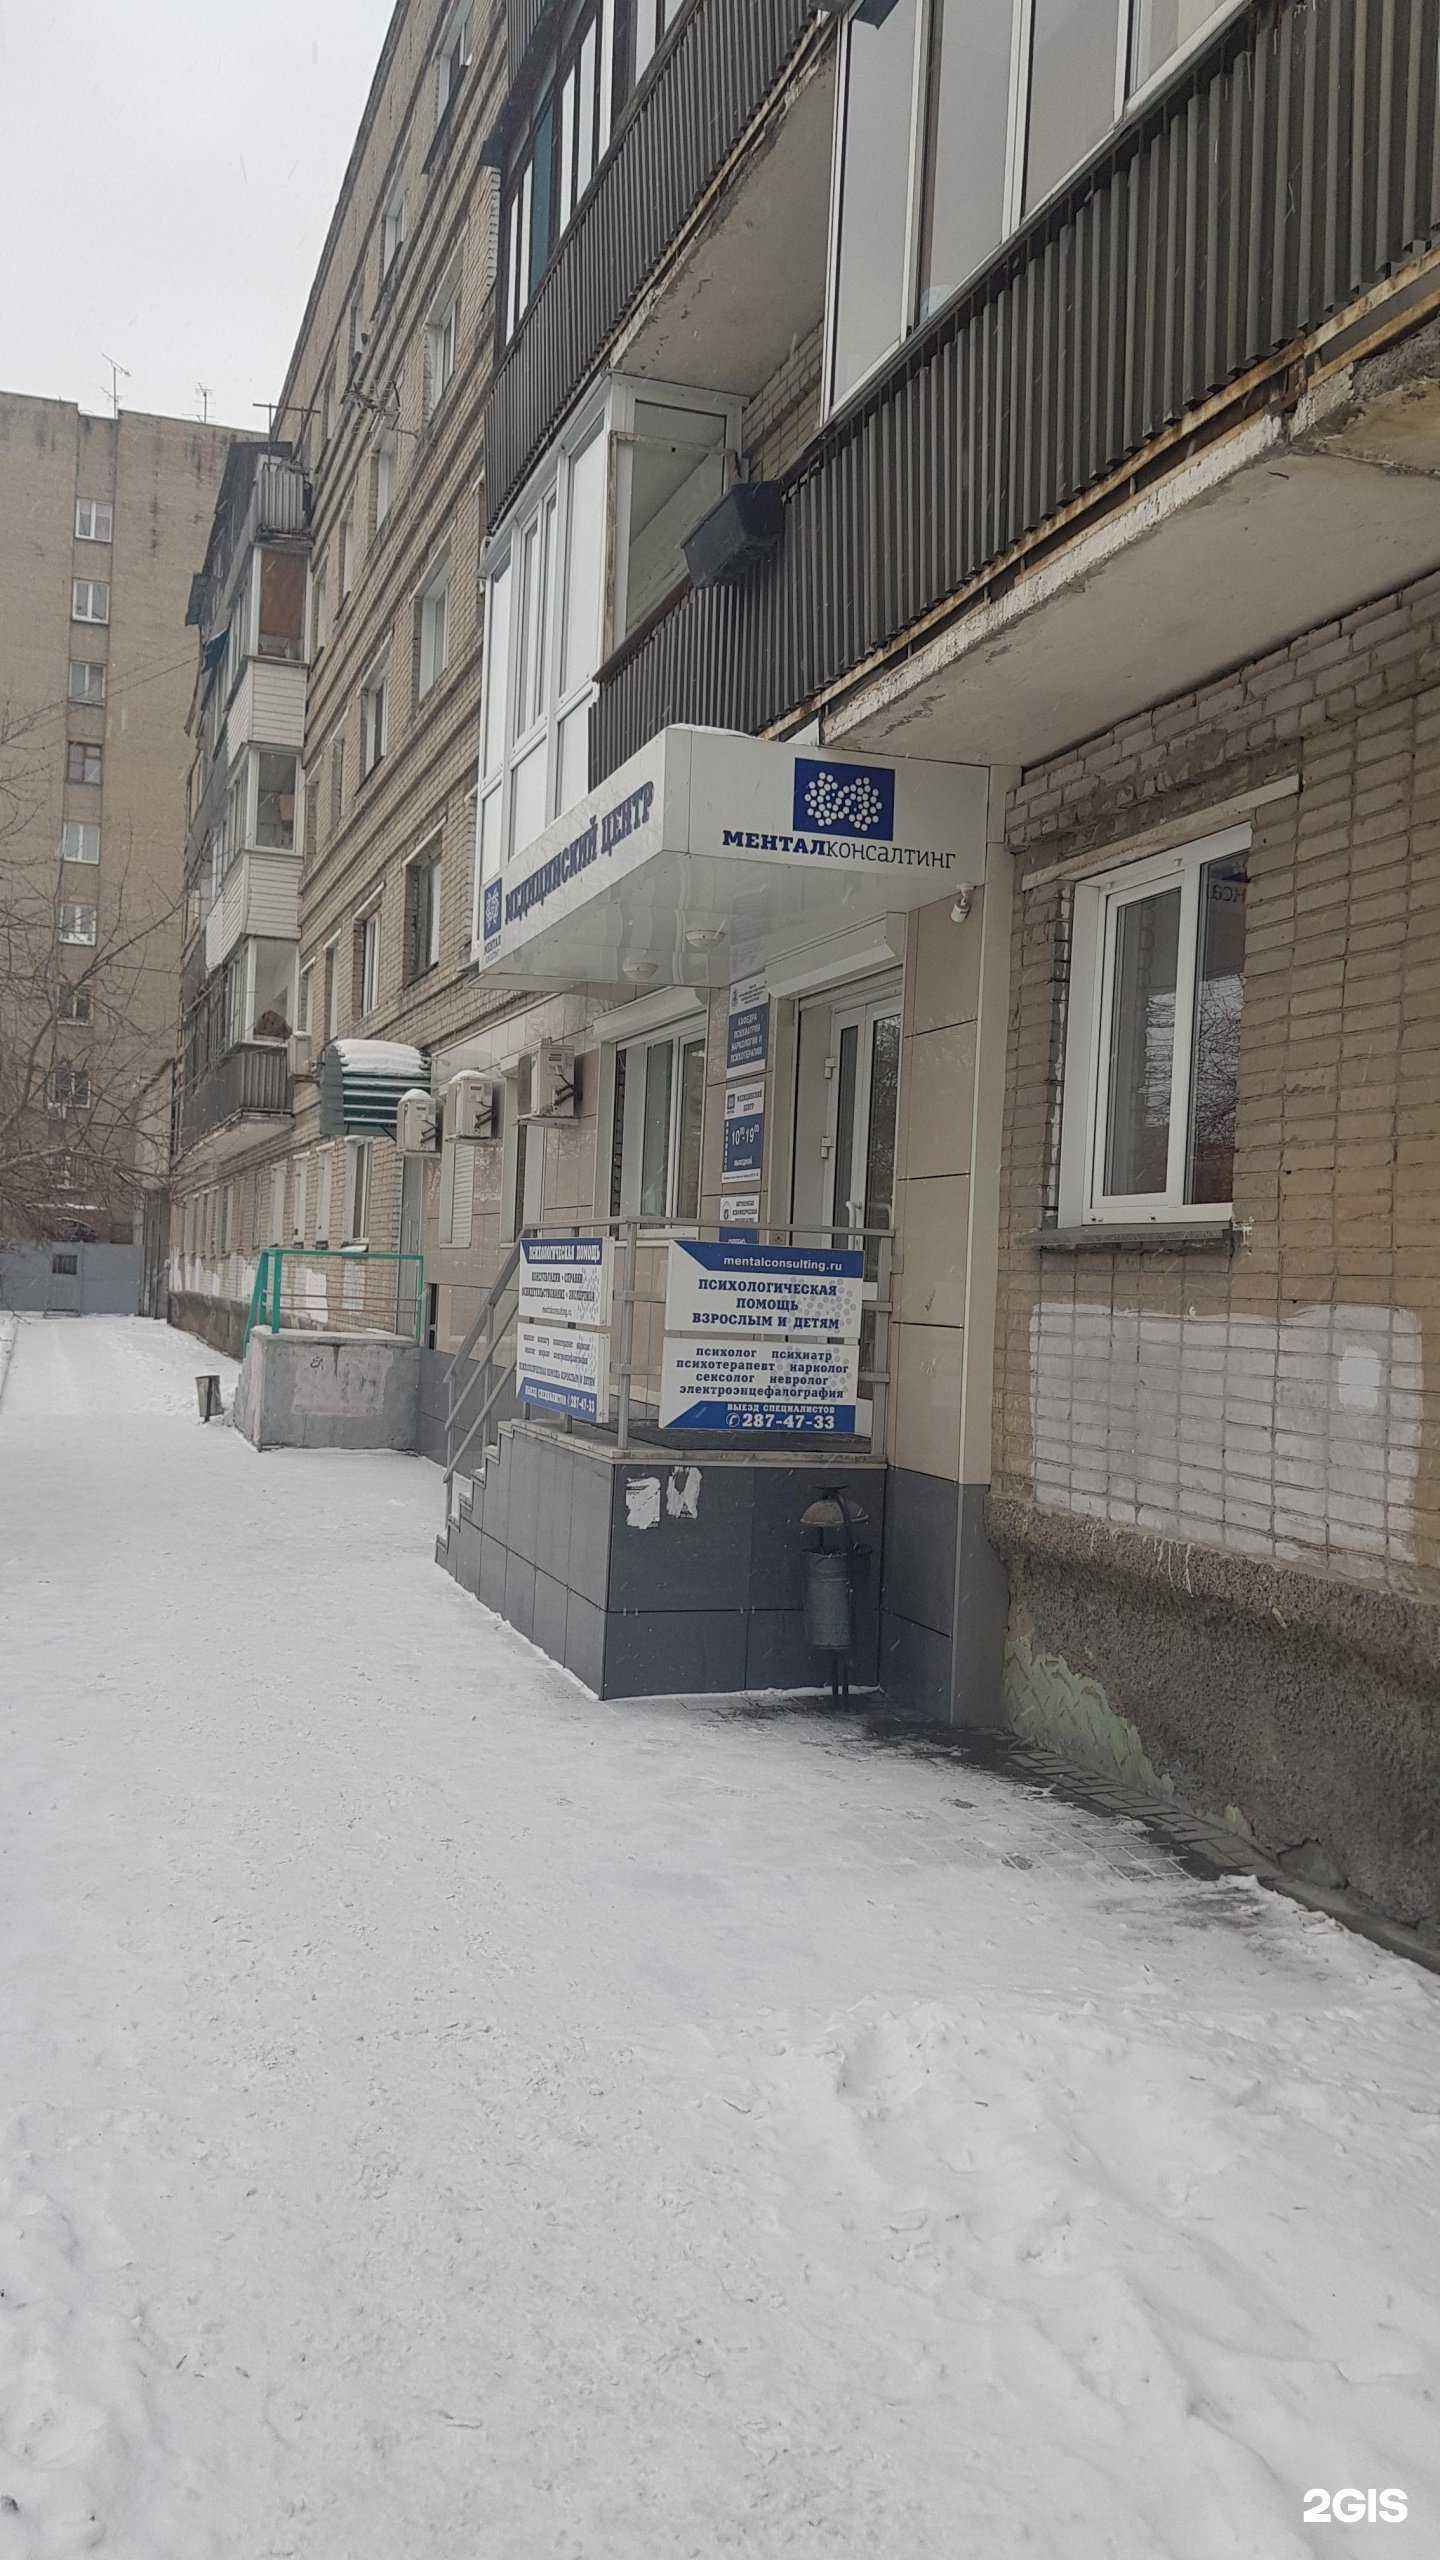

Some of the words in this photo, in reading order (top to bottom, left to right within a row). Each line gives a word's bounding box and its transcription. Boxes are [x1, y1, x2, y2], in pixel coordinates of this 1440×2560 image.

[505, 814, 598, 925] МЕДИЦИНСКИЙ
[600, 780, 654, 857] ЦЕНТР
[723, 1256, 843, 1271] mentalconsulting.ru
[698, 1278, 838, 1296] ПСИХОЛОГИЧЕСКАЯ
[735, 1297, 799, 1312] ПОМОЩЬ
[692, 1312, 773, 1328] ВЗРОСЛЫМ
[777, 1316, 787, 1328] И
[793, 1317, 840, 1330] ДЕТЯМ
[696, 1347, 757, 1358] психолог
[771, 1349, 833, 1363] психиатр
[676, 1359, 776, 1372] психотерапевт
[789, 1363, 849, 1375] нарколог
[695, 1373, 756, 1383] сексолог
[769, 1376, 829, 1387] невролог
[679, 1384, 844, 1400] электроэнцефалография
[727, 1403, 760, 1413] ВЫЕЗД
[762, 1404, 835, 1414] СПЕЦИАЛИСТОВ
[741, 1413, 835, 1429] 287-47-33
